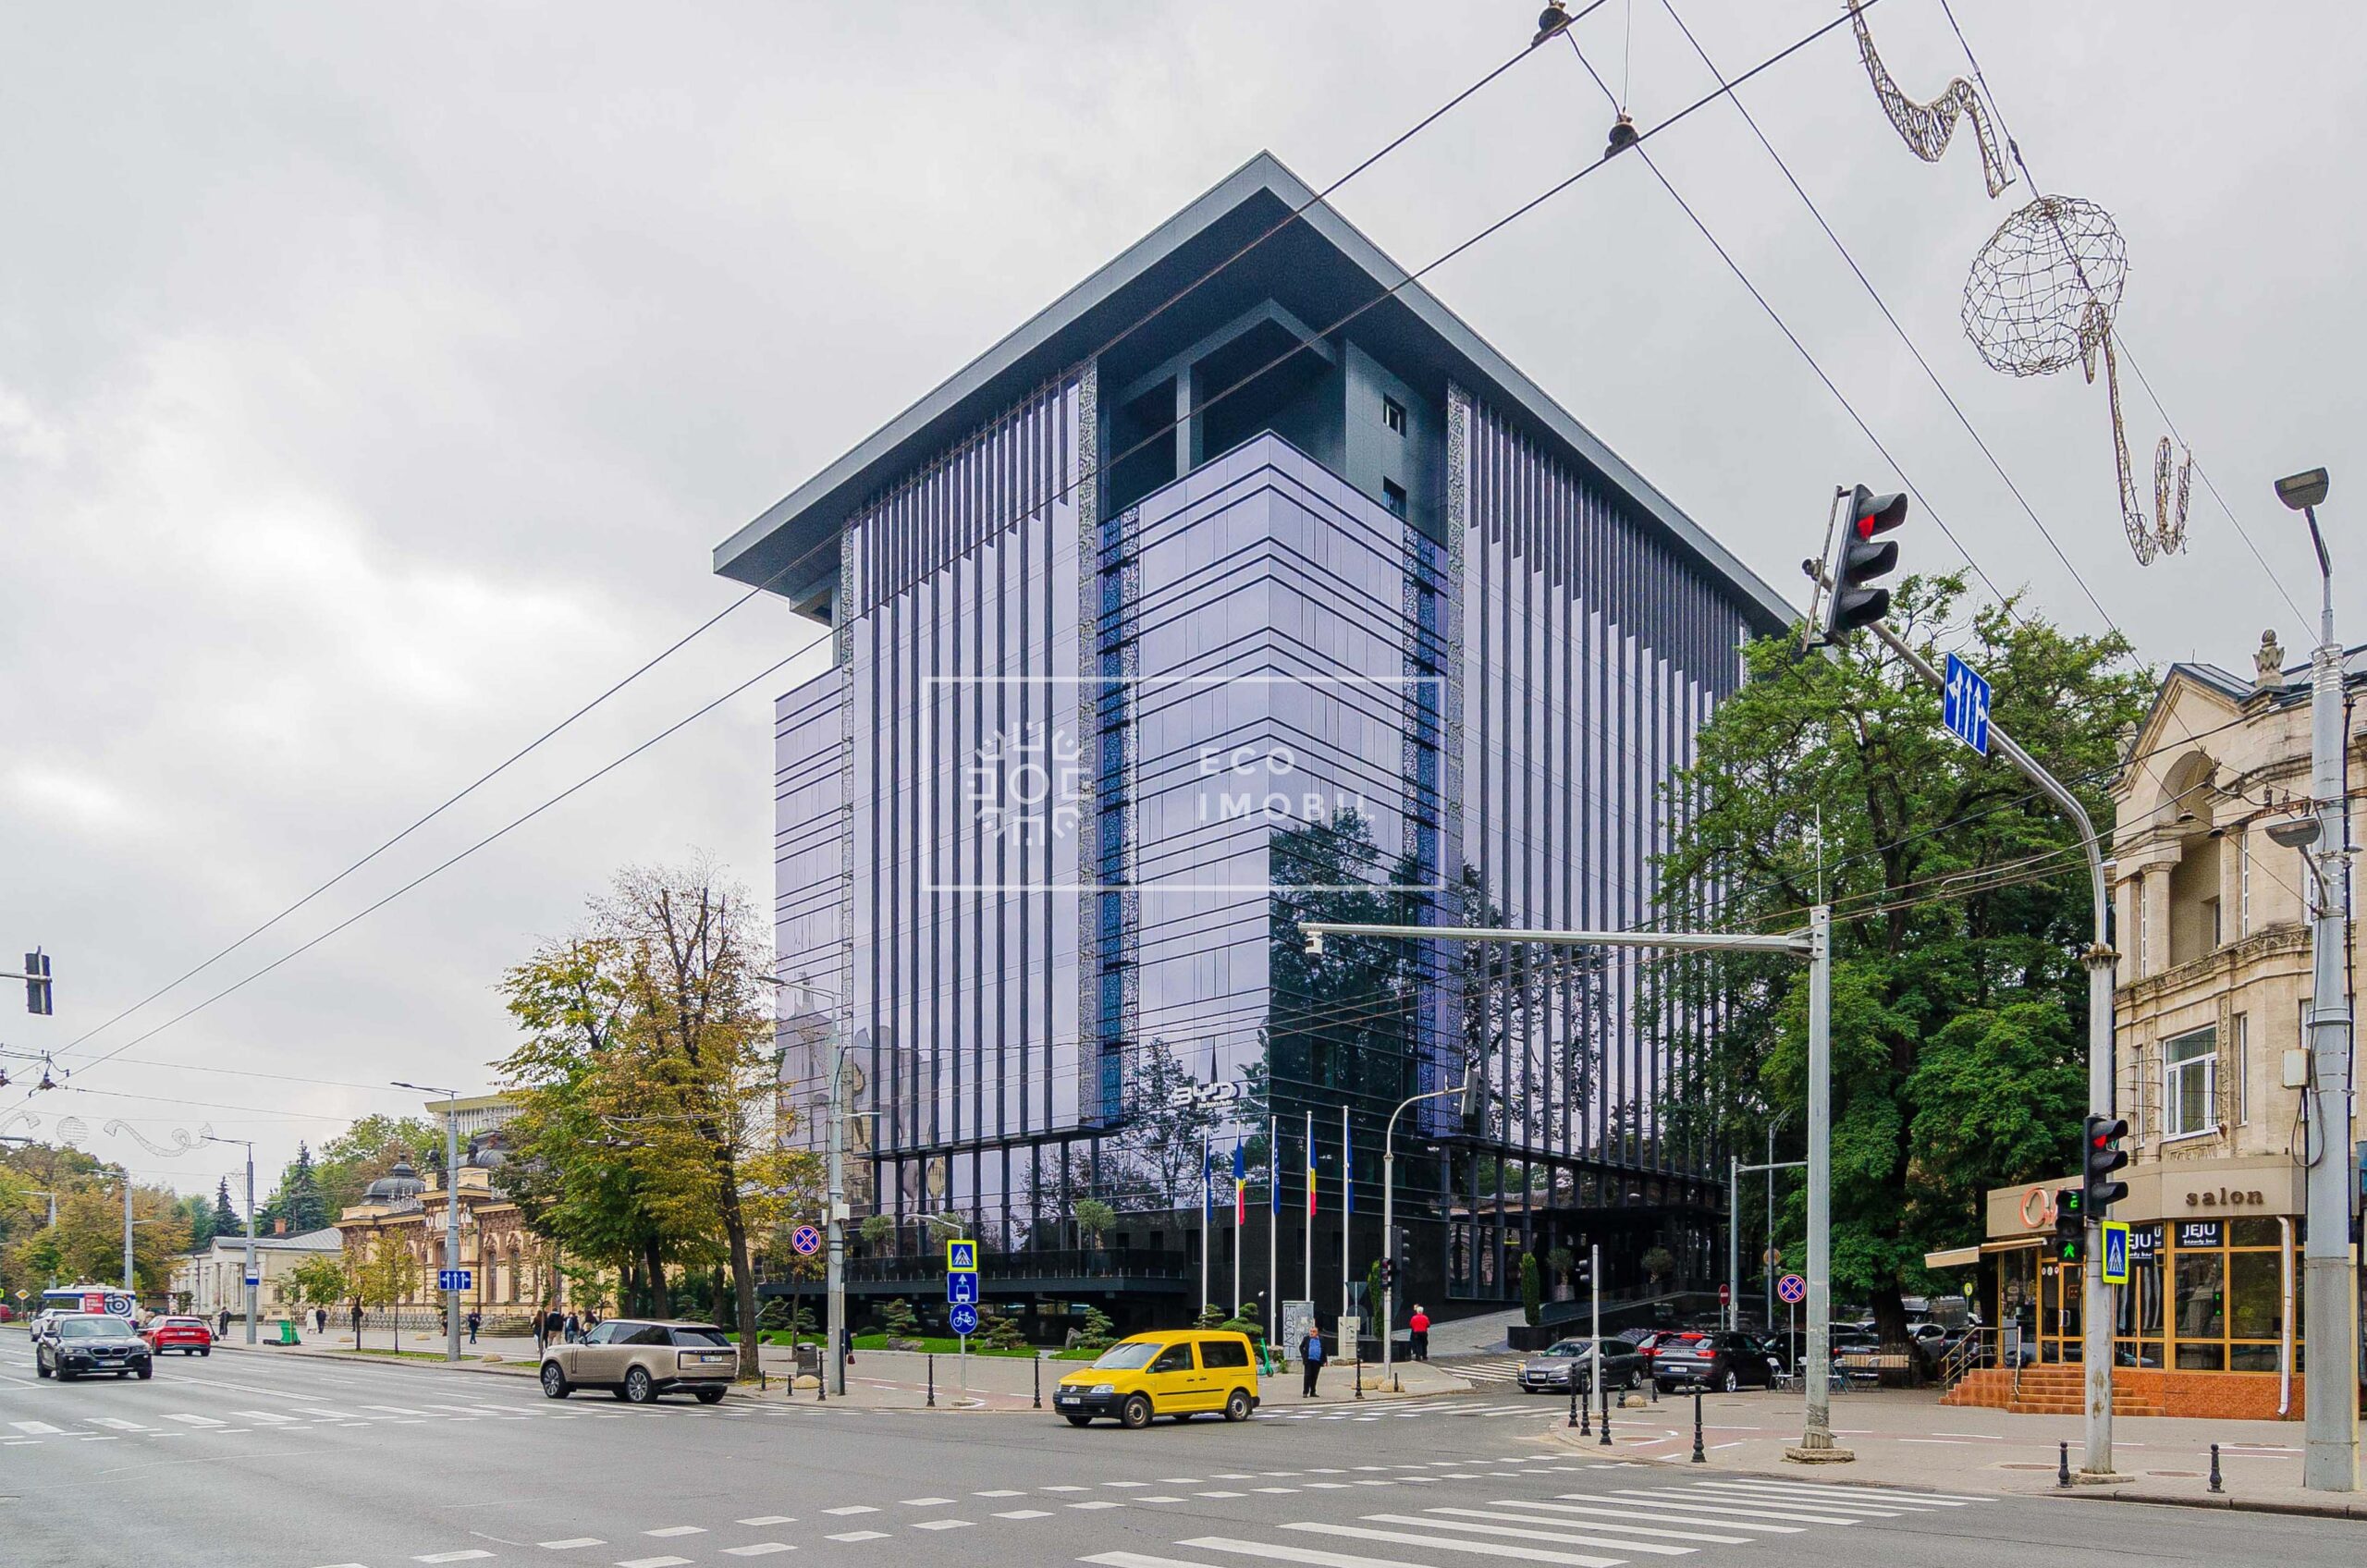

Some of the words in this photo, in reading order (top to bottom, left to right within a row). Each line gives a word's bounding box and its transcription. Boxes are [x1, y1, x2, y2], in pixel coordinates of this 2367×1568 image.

[1173, 1082, 1236, 1107] BYD
[2186, 1187, 2263, 1207] salon
[2182, 1223, 2215, 1238] JEJU
[2128, 1233, 2152, 1249] EJU
